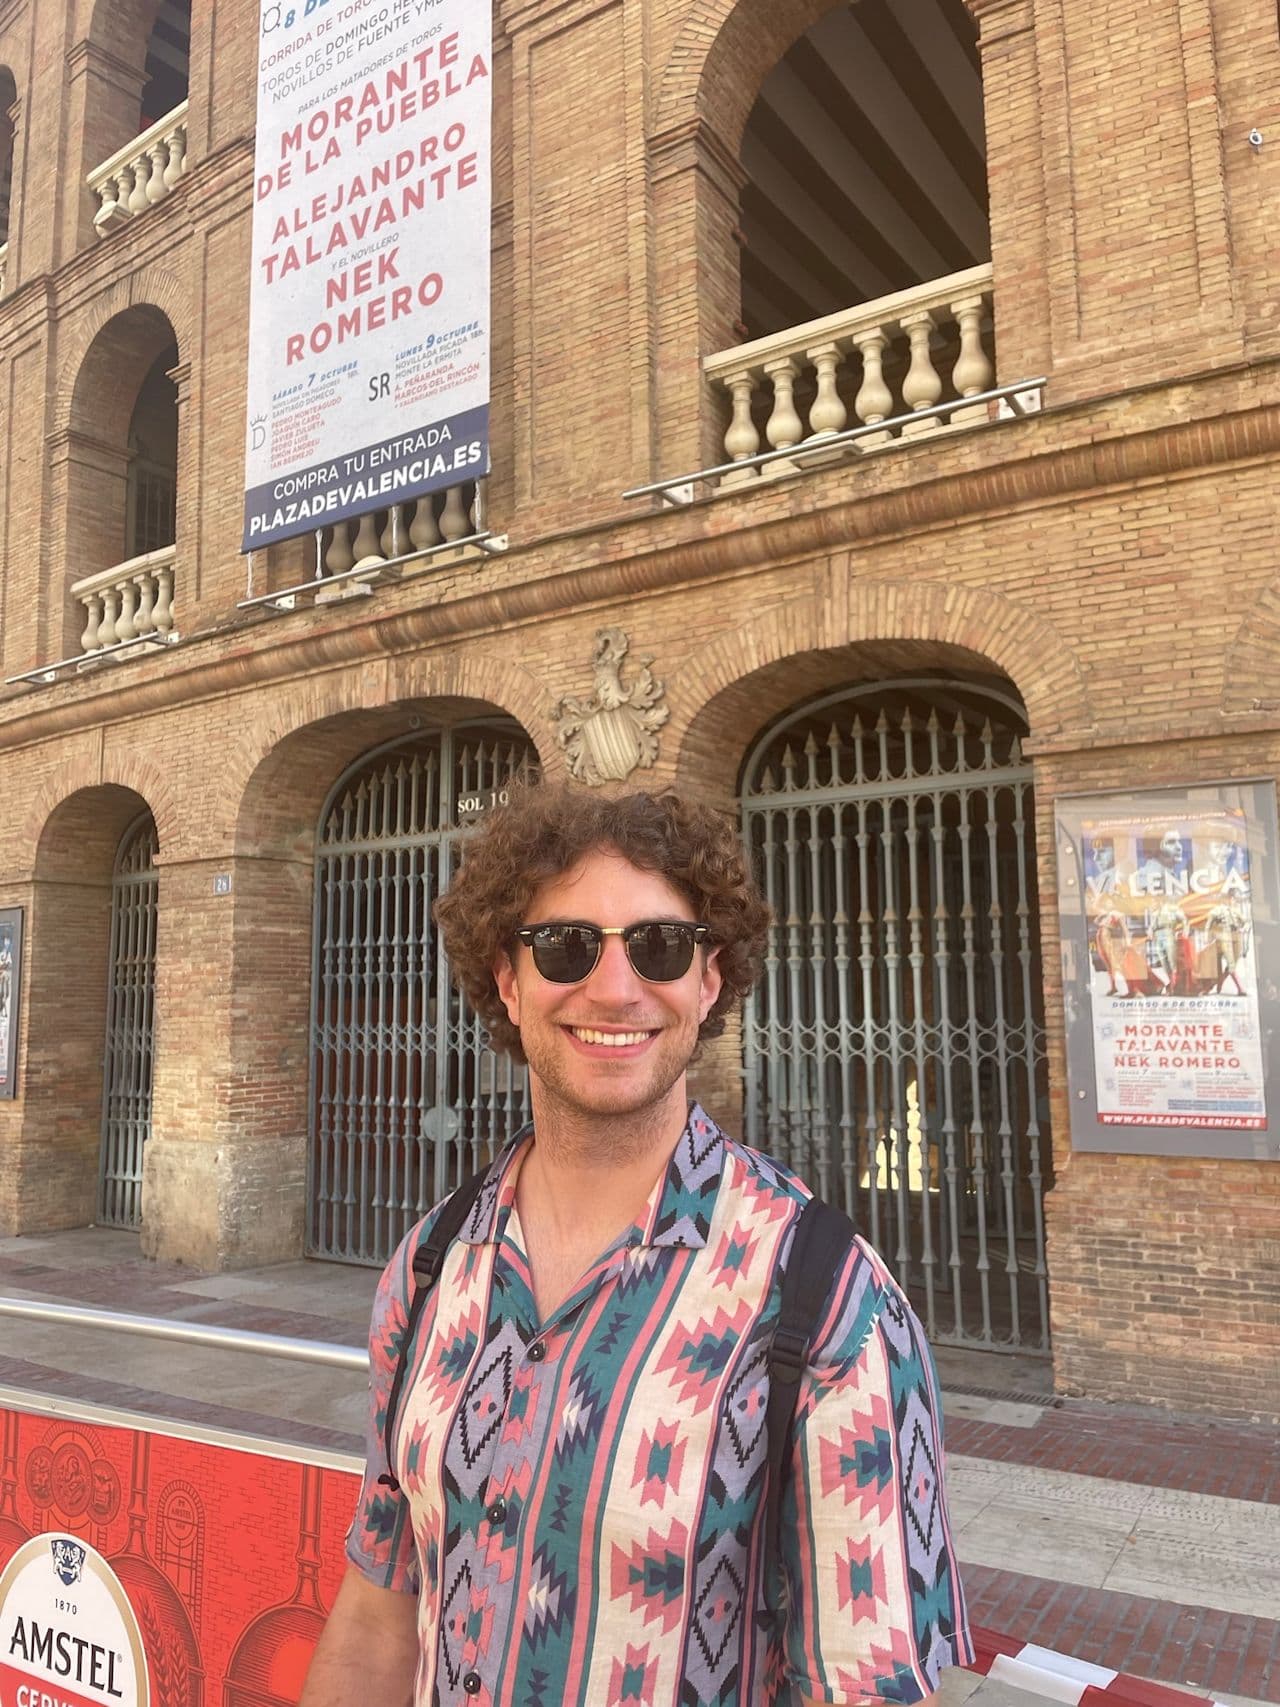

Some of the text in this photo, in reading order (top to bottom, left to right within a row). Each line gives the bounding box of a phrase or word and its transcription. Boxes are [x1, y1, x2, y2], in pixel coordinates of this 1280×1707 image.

[260, 0, 376, 73] CORRIDA DE TORO
[284, 9, 296, 29] 8
[261, 63, 302, 95] TOROS
[306, 49, 322, 69] DE
[326, 8, 389, 56] DOMINGO
[272, 61, 333, 103] NOVILLOS
[337, 45, 354, 65] DE
[357, 11, 410, 52] FUENTE
[298, 23, 443, 115] PARA LOS MATADORES DE TOROS
[280, 31, 459, 160] MORANTE
[257, 54, 489, 201] DE LA PUEBLA
[271, 122, 466, 245] ALEJANDRO
[261, 151, 478, 285] TALAVANTE
[331, 232, 400, 272] Y EL NOVILLERO
[326, 247, 400, 309] NEK
[286, 272, 444, 366] ROMERO
[395, 321, 479, 362] LUNES 9 OCTUBRE
[395, 347, 438, 371] NOVILLADA
[272, 360, 359, 402] SÁBADO 7 OCTUBRE
[395, 348, 462, 380] MONTE LA ERMITA
[369, 371, 391, 402] SR
[394, 382, 428, 402] MARCOS
[272, 401, 305, 419] SANTIAGO
[273, 424, 453, 501] COMPRA TU ENTRADA
[250, 441, 482, 537] PLAZADEVALENCIA.ES
[457, 797, 485, 814] SOL
[1116, 1040, 1234, 1053] TALAVANTE
[1124, 1025, 1224, 1037] MORANTE
[1114, 1056, 1241, 1069] NEK ROMERO
[1103, 1115, 1261, 1128] WWW.PLAZADEVALENCIA.ES
[54, 1598, 78, 1615] 1870
[8, 1615, 123, 1698] AMSTEL
